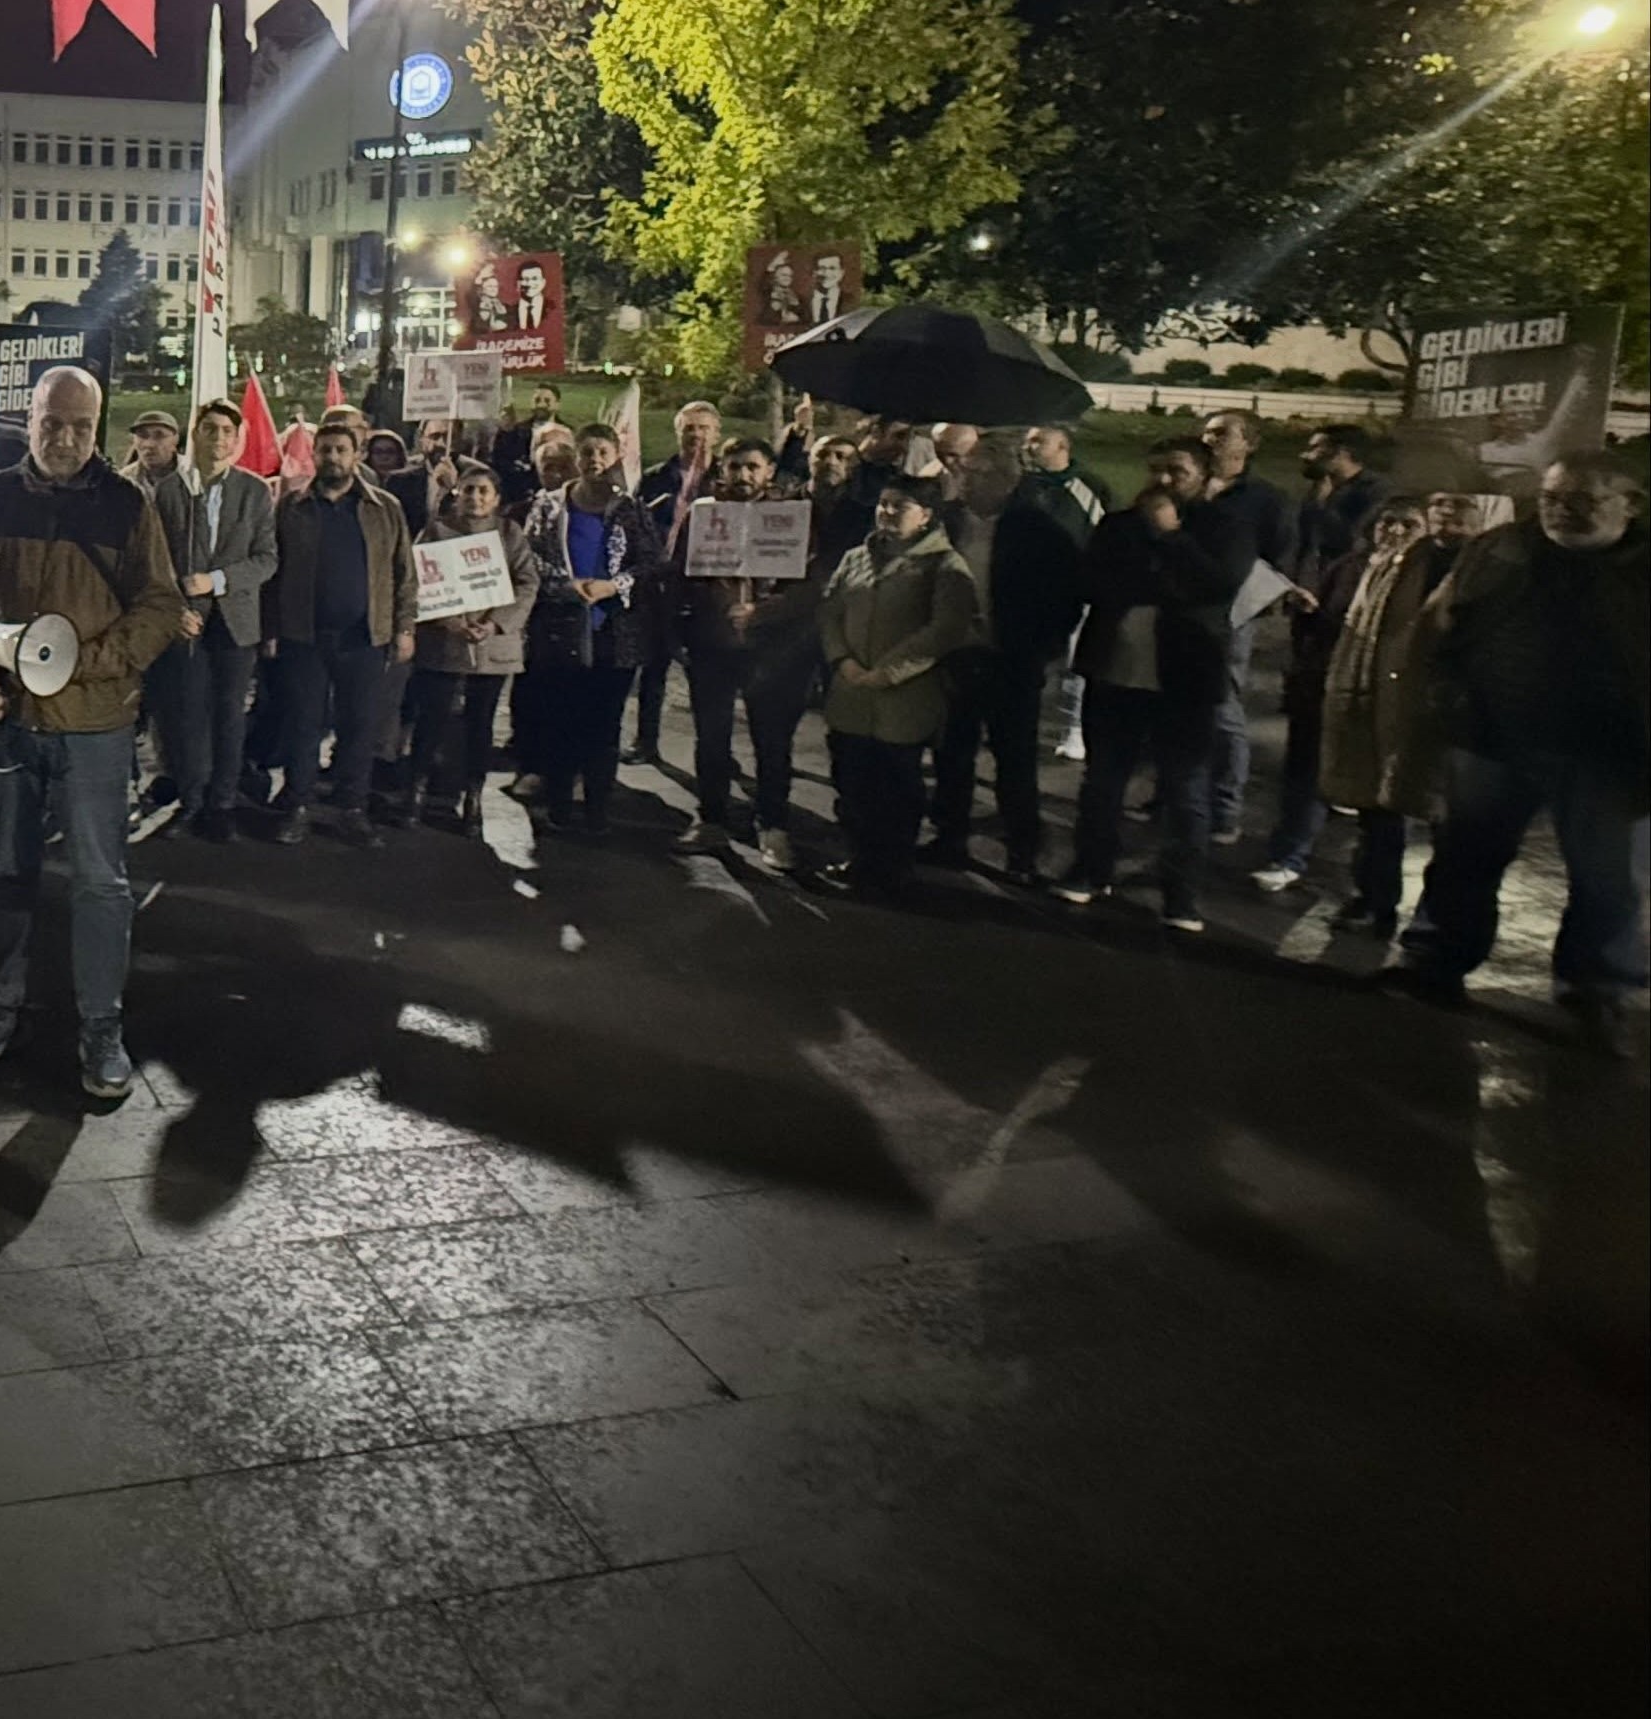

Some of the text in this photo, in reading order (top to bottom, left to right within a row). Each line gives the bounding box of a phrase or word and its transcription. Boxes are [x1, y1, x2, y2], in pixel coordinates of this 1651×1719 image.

[0, 331, 85, 362] GELDİKLERİ
[1420, 311, 1567, 360] GELDİKLERİ
[501, 350, 547, 369] ÜRLÜK
